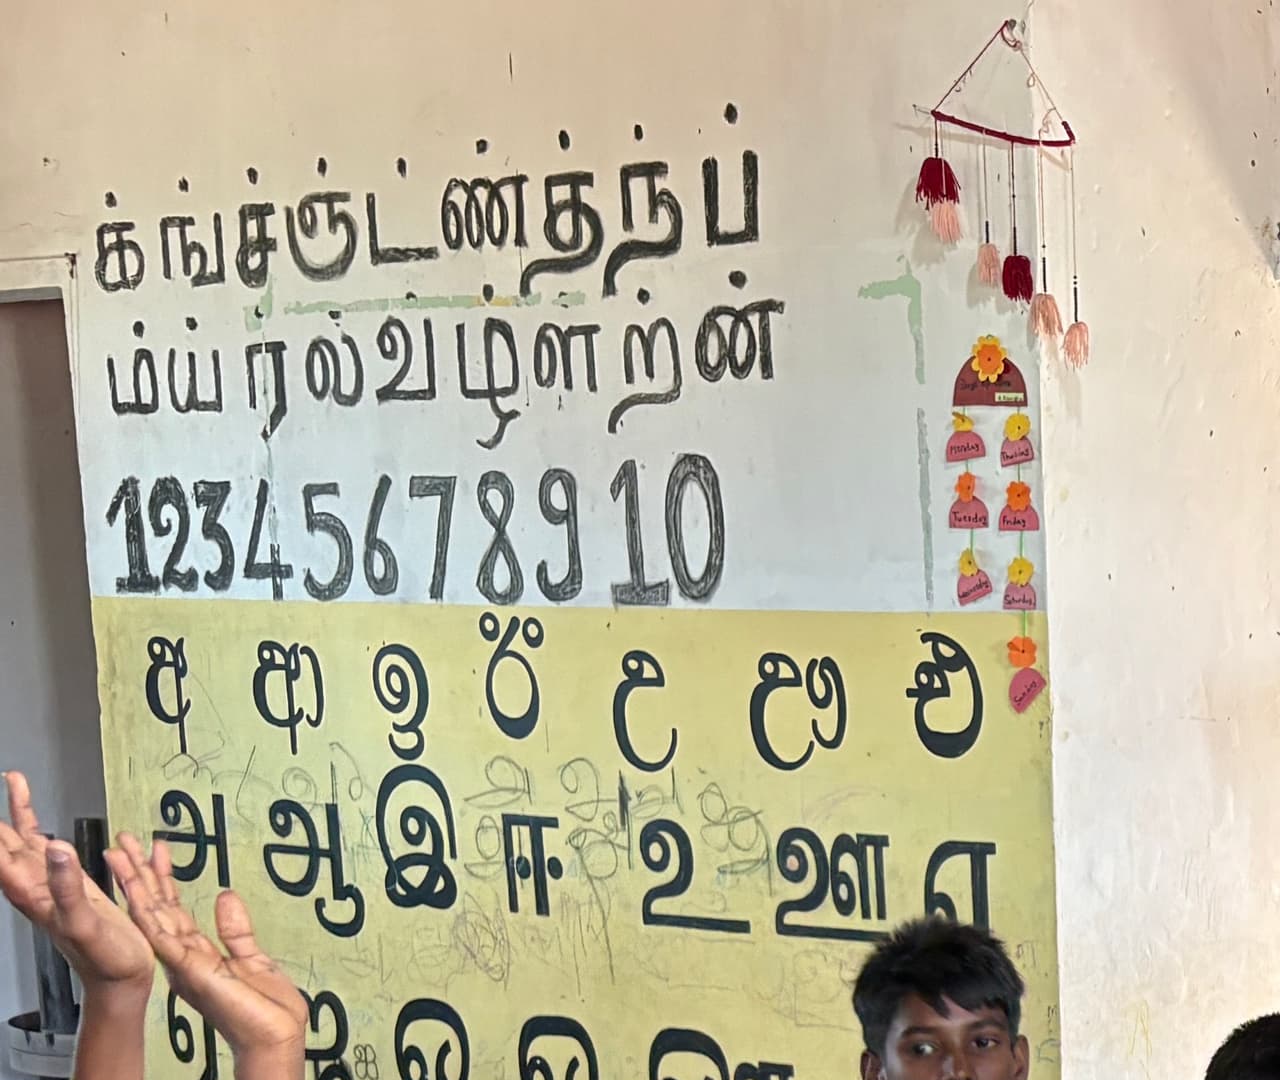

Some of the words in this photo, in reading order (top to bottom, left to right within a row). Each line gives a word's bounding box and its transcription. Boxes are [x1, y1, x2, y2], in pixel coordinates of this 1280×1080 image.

[146, 637, 191, 754] අ
[253, 640, 324, 755] ආ
[372, 644, 429, 761] ඉ
[479, 612, 544, 739] ඊ
[613, 650, 677, 772] උ
[153, 790, 230, 888] அ
[264, 799, 366, 938] ஆ
[376, 764, 457, 910] இ
[502, 814, 563, 916] ஈ
[640, 819, 750, 933] உ
[776, 827, 892, 942] ஊ
